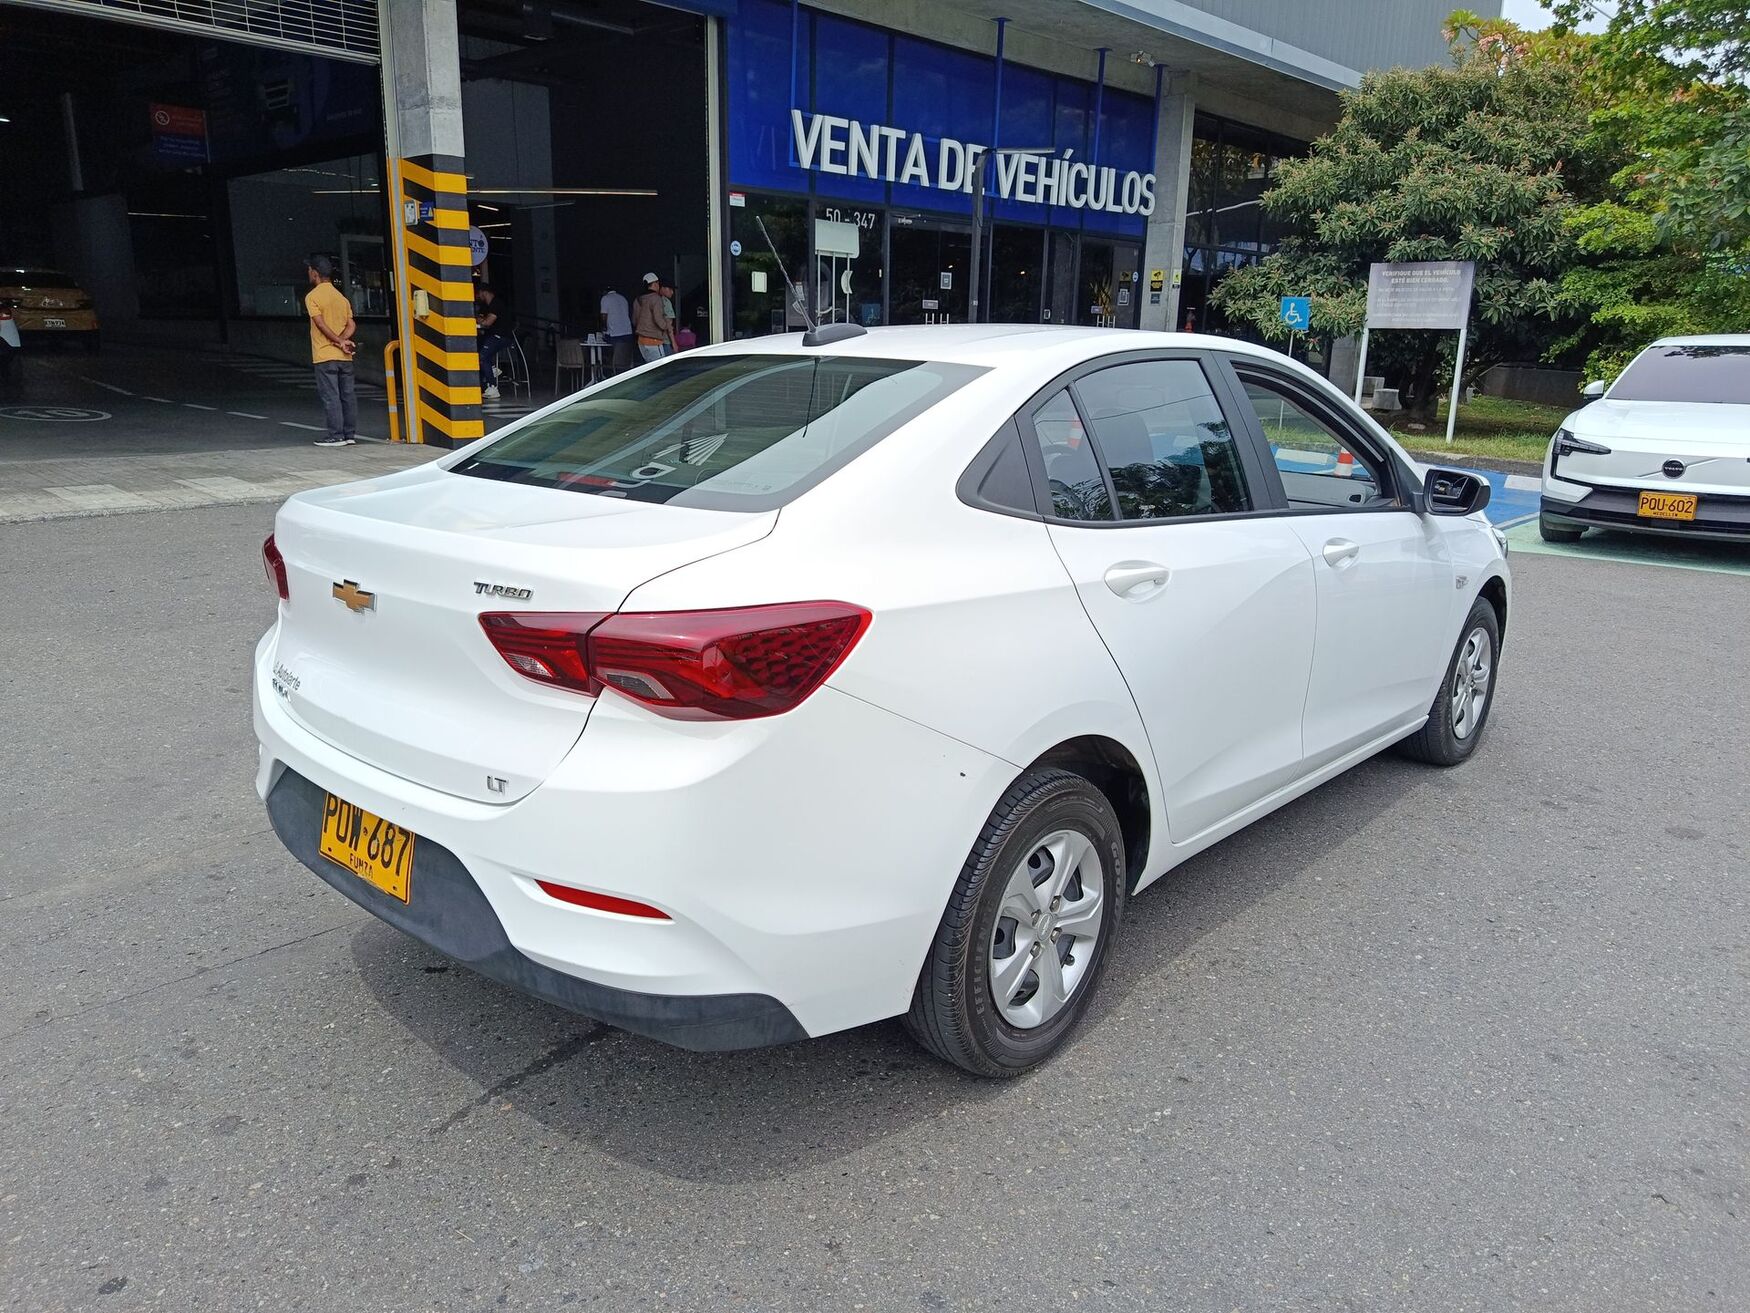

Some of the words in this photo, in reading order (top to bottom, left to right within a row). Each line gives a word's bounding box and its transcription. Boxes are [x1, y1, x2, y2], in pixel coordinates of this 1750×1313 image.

[791, 109, 930, 187] VENTA
[938, 138, 985, 196] DE
[996, 148, 1157, 216] VEHÍCULOS
[826, 208, 841, 223] 50
[854, 211, 875, 229] 347
[474, 582, 533, 600] TURBO
[487, 776, 508, 794] LT
